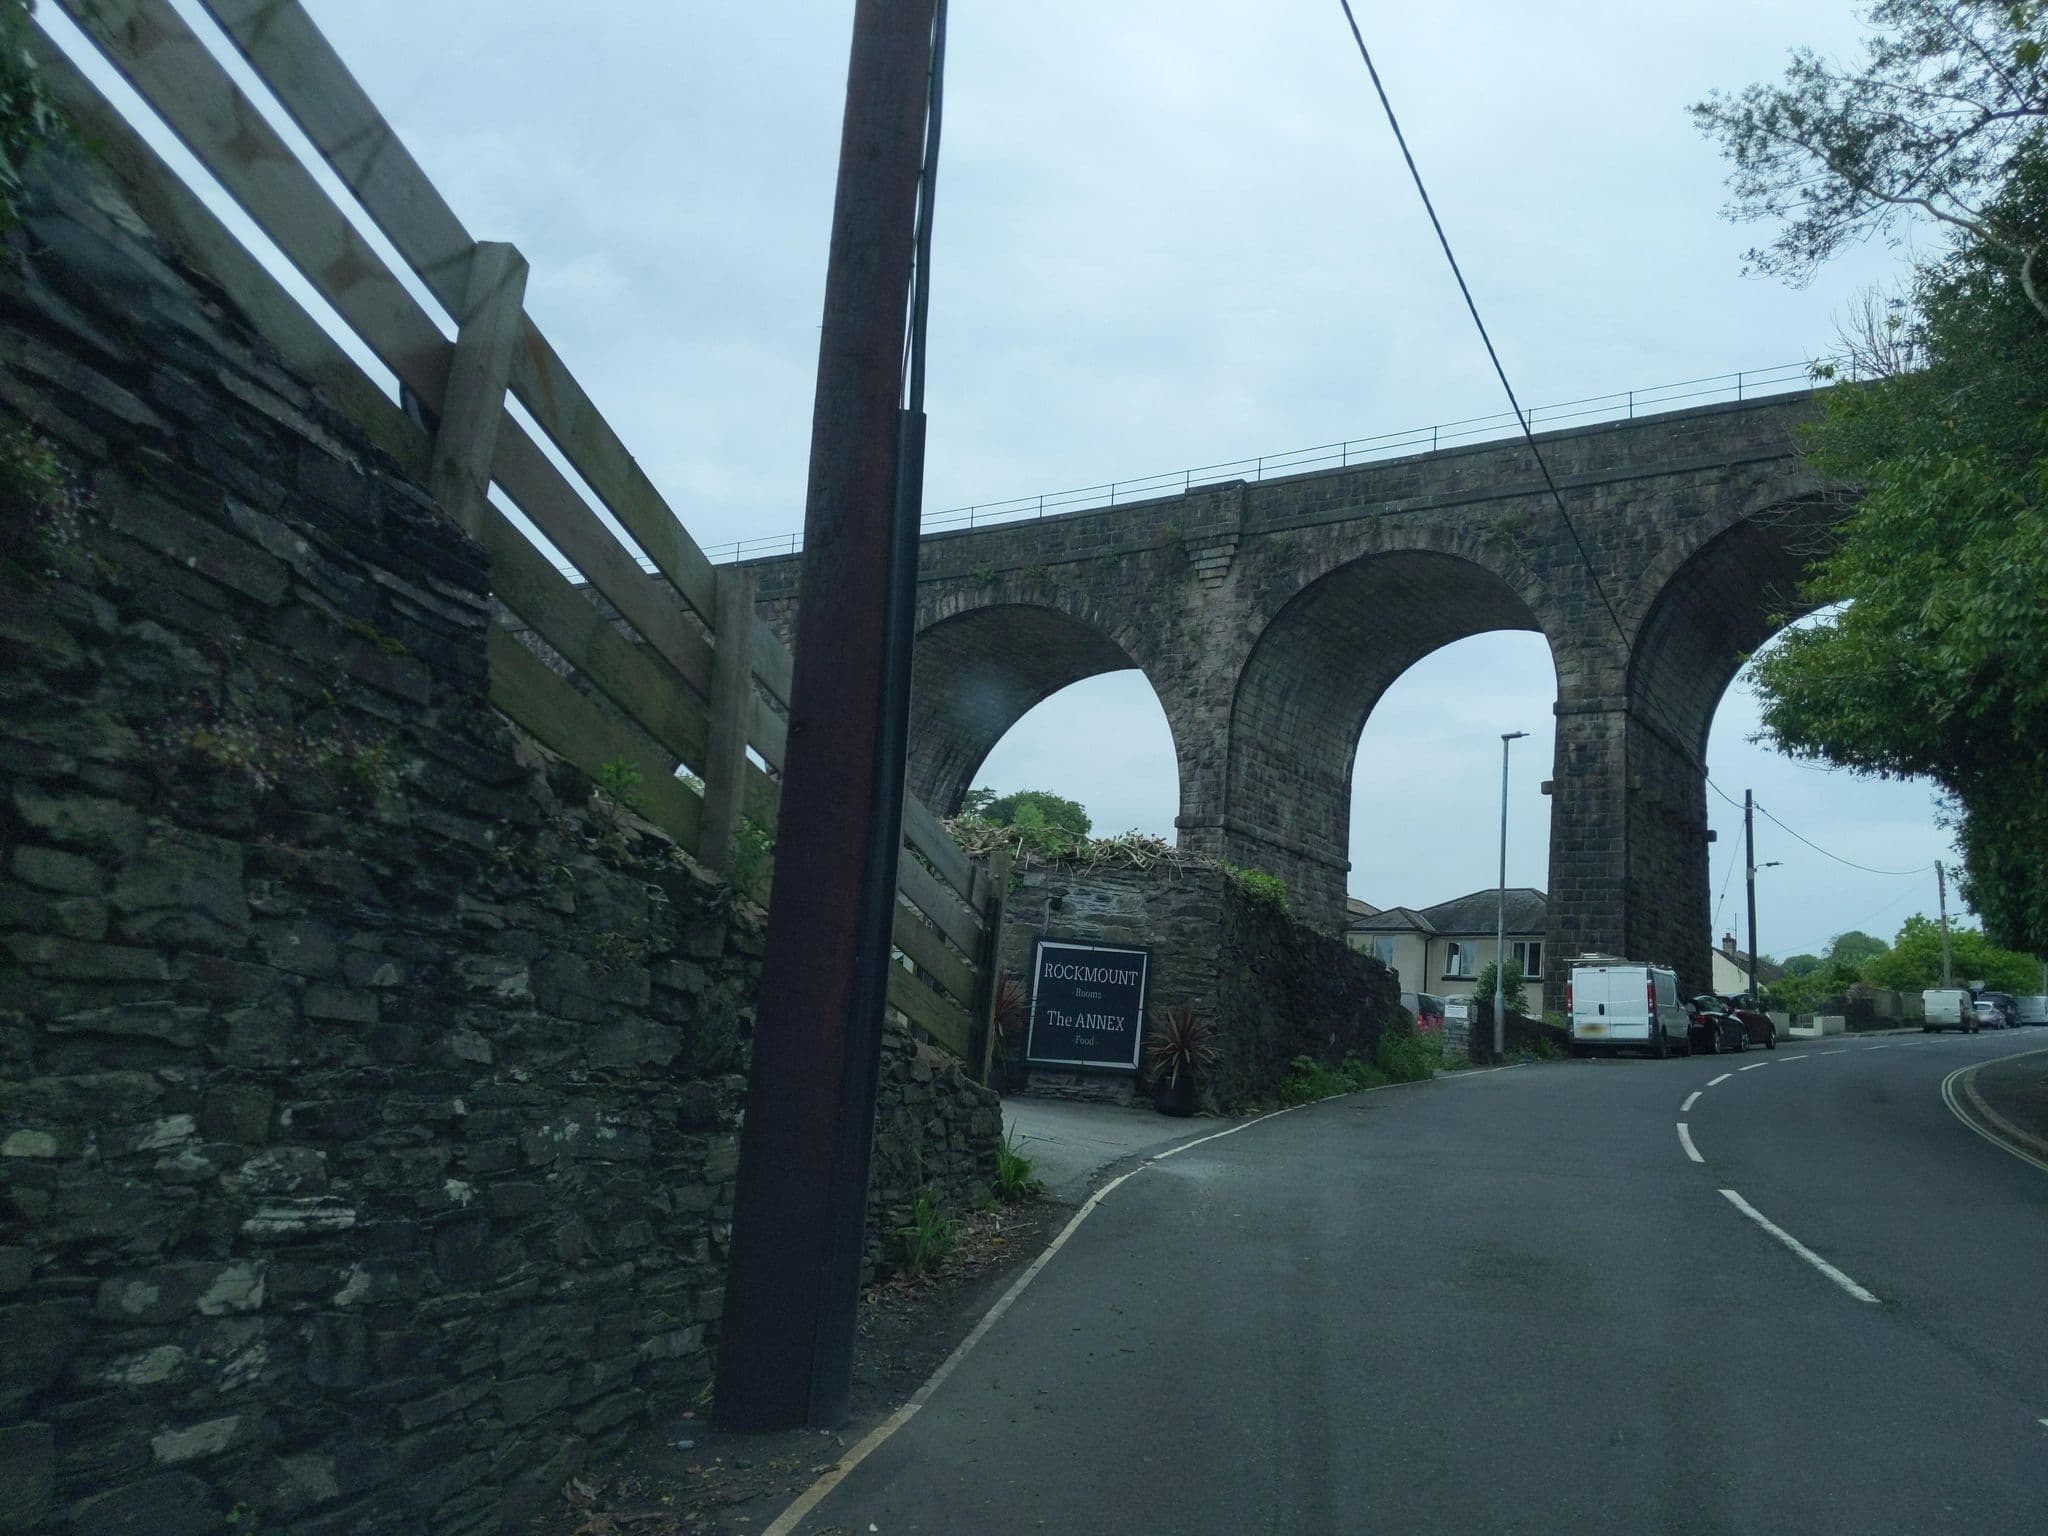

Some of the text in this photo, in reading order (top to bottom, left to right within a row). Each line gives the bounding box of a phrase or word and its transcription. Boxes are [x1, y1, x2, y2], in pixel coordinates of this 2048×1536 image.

[1044, 962, 1139, 986] ROCKMOUNT
[1075, 987, 1102, 1000] Rooms
[1047, 1010, 1125, 1032] The ANNEX
[1074, 1035, 1095, 1046] Food
